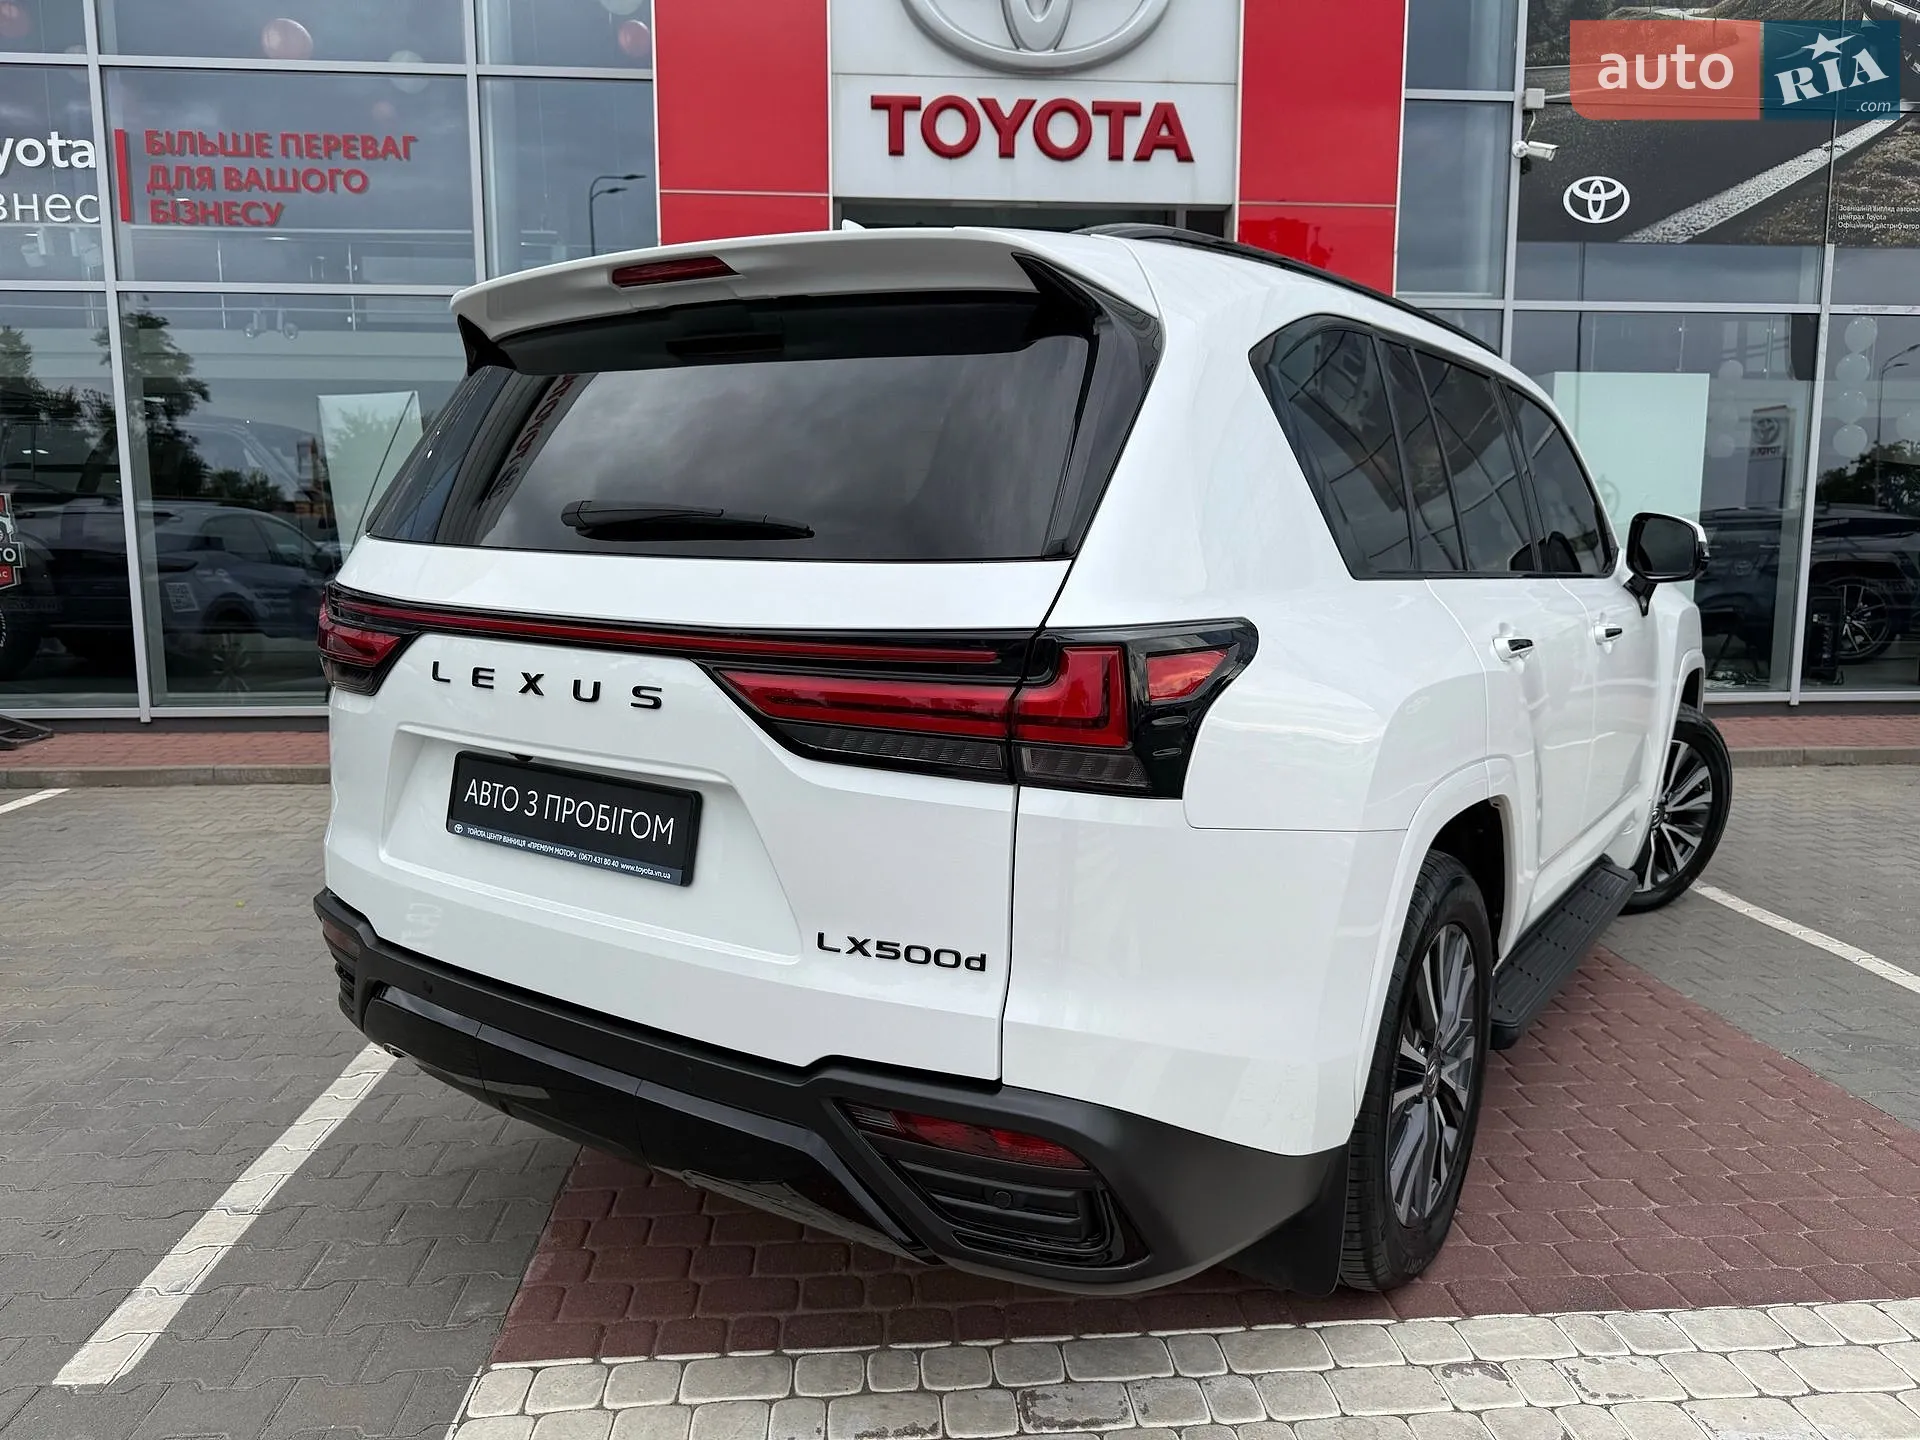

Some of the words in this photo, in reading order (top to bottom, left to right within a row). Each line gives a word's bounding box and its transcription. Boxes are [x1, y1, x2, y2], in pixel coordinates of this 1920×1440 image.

[145, 129, 273, 158] БІЛЬШЕ
[280, 131, 417, 161] ПЕРЕВАГ
[870, 94, 1195, 163] TOYOTA
[146, 164, 214, 195] ДЛЯ
[223, 166, 369, 193] ВАШОГО
[150, 199, 284, 226] БІЗНЕСУ
[1866, 213, 1887, 221] Toyota
[431, 660, 663, 710] LEXUS
[464, 778, 519, 812] АВТО
[543, 793, 675, 845] ПРОБІГОМ
[486, 831, 502, 841] ЦЕНТР
[578, 852, 593, 863] (067)
[593, 856, 603, 864] 431
[611, 860, 619, 868] 40
[620, 862, 671, 879] www.toyota.vn.ua
[817, 931, 987, 972] LX500d
